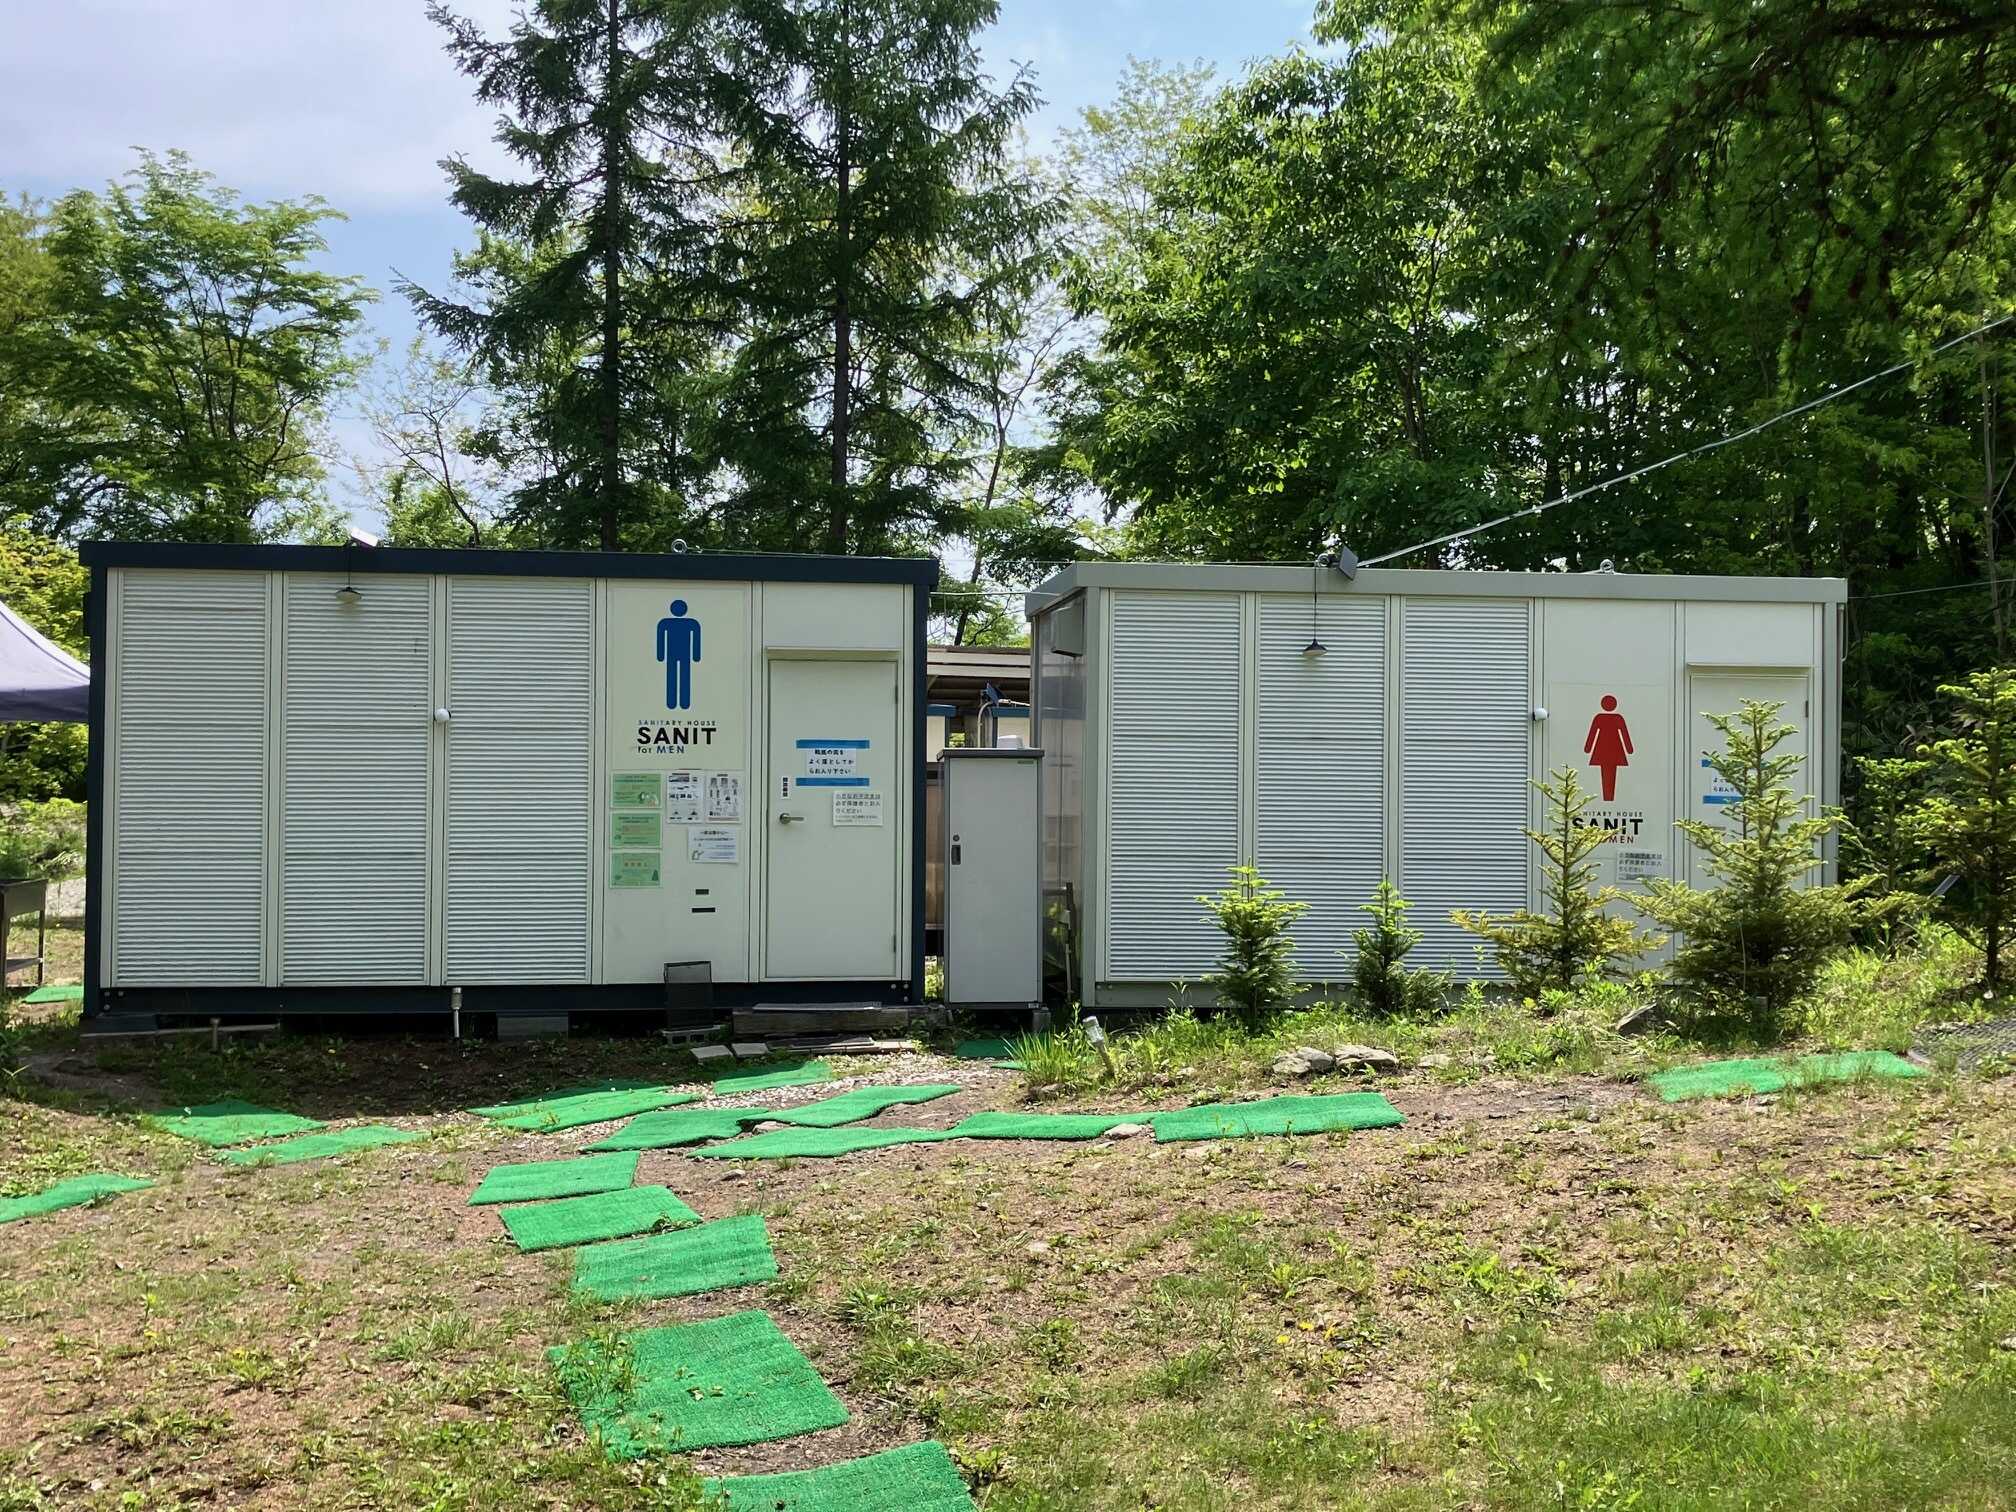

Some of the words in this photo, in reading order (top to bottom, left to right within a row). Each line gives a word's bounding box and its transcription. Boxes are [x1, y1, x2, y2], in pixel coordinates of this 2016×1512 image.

[636, 726, 717, 745] SANIT
[638, 745, 652, 754] for
[656, 745, 685, 754] MEN
